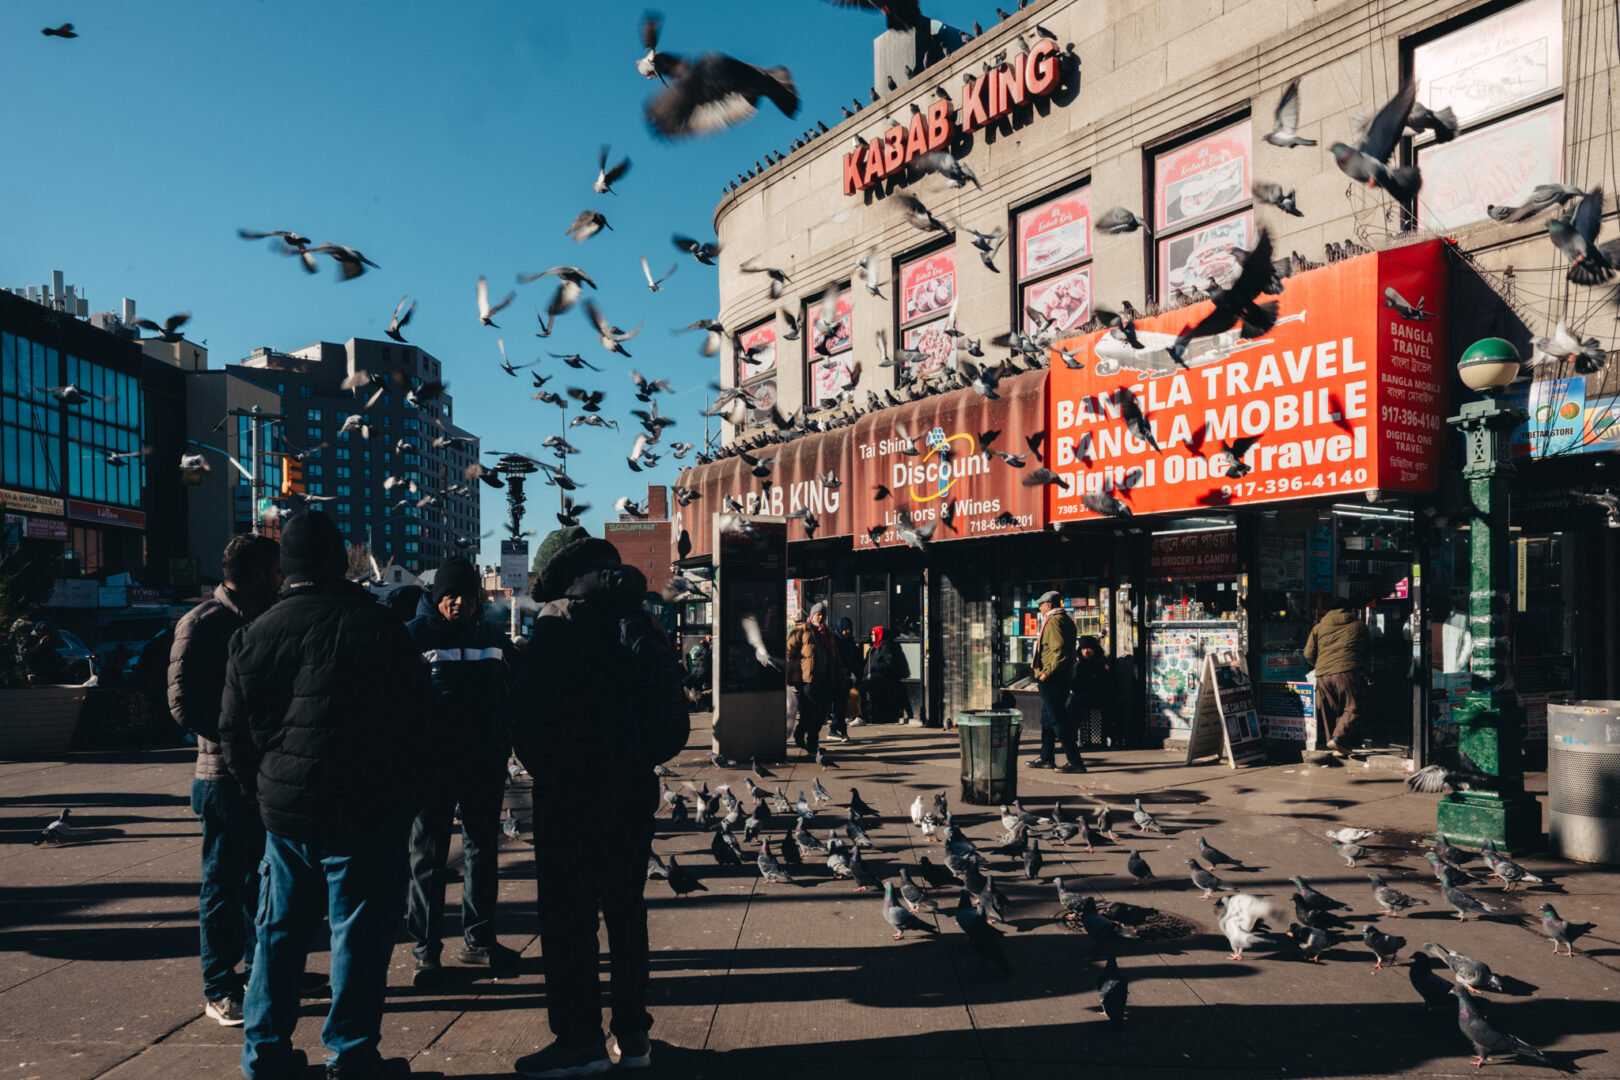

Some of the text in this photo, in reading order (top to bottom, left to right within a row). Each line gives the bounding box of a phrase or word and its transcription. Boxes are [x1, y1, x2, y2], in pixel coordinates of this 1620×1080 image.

[842, 38, 1061, 196] KABAB KING
[1390, 322, 1434, 345] BANGLA
[1392, 338, 1432, 360] TRAVEL
[1057, 336, 1367, 430] BANGLA TRAVEL
[1381, 372, 1441, 394] BANGLA MOBILE
[1057, 380, 1367, 467] BANGLA MOBILE
[1381, 405, 1440, 431] 917-396-4140
[1386, 429, 1433, 446] DIGITAL ONE
[1551, 427, 1574, 437] STORE
[859, 437, 908, 460] Tai Shin
[1395, 441, 1424, 455] TRAVEL
[893, 454, 990, 489] Discount
[1057, 426, 1367, 499] Digital One Travel
[1222, 468, 1368, 499] 917-396-4140
[790, 479, 840, 515] KING
[940, 502, 951, 518] &
[955, 498, 1001, 517] Wines
[1058, 504, 1078, 515] 7305
[970, 514, 1033, 533] 718-639-7201
[859, 532, 881, 545] 73-05
[884, 531, 894, 543] 37
[1162, 555, 1196, 567] GROCERY
[1197, 554, 1203, 565] &
[1204, 553, 1230, 564] CANDY
